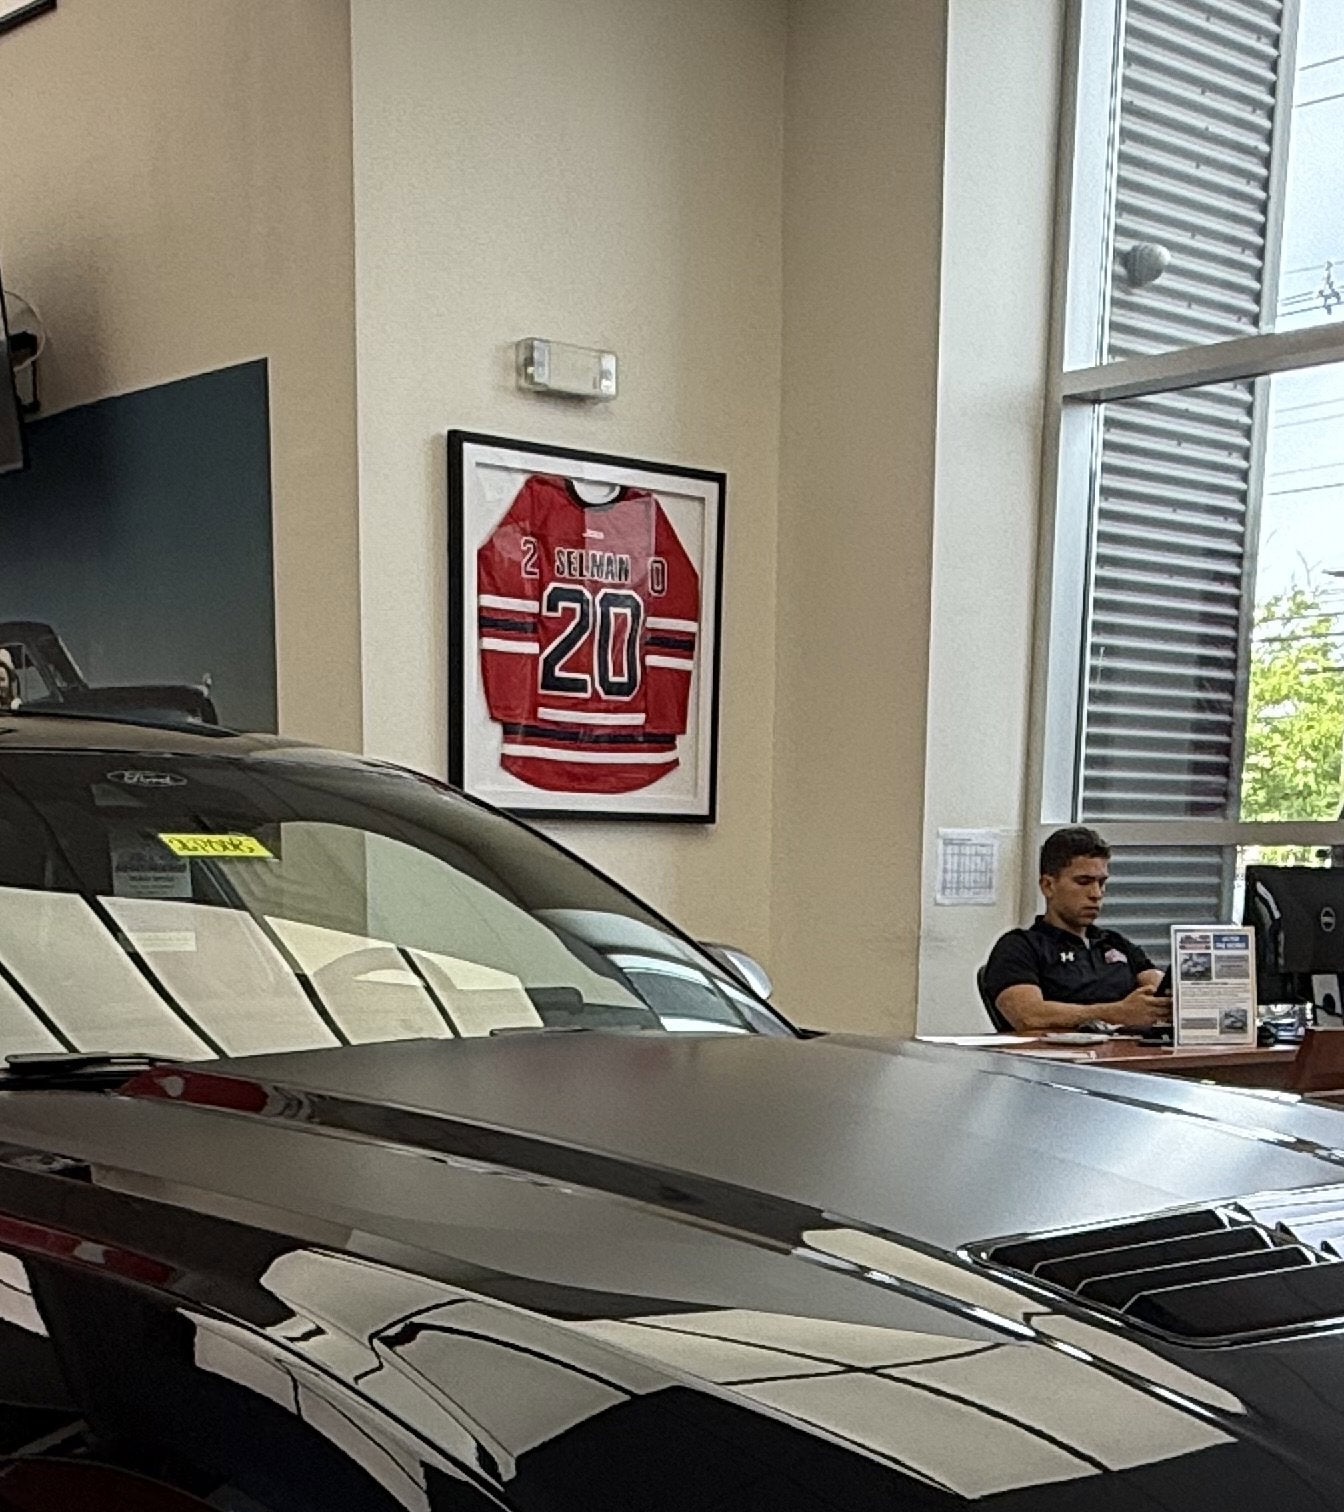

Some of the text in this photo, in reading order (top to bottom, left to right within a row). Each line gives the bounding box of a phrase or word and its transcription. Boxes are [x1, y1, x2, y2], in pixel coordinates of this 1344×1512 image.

[520, 537, 540, 579] 2
[555, 547, 631, 583] SELMAN
[648, 556, 668, 597] 0
[537, 582, 646, 701] 20
